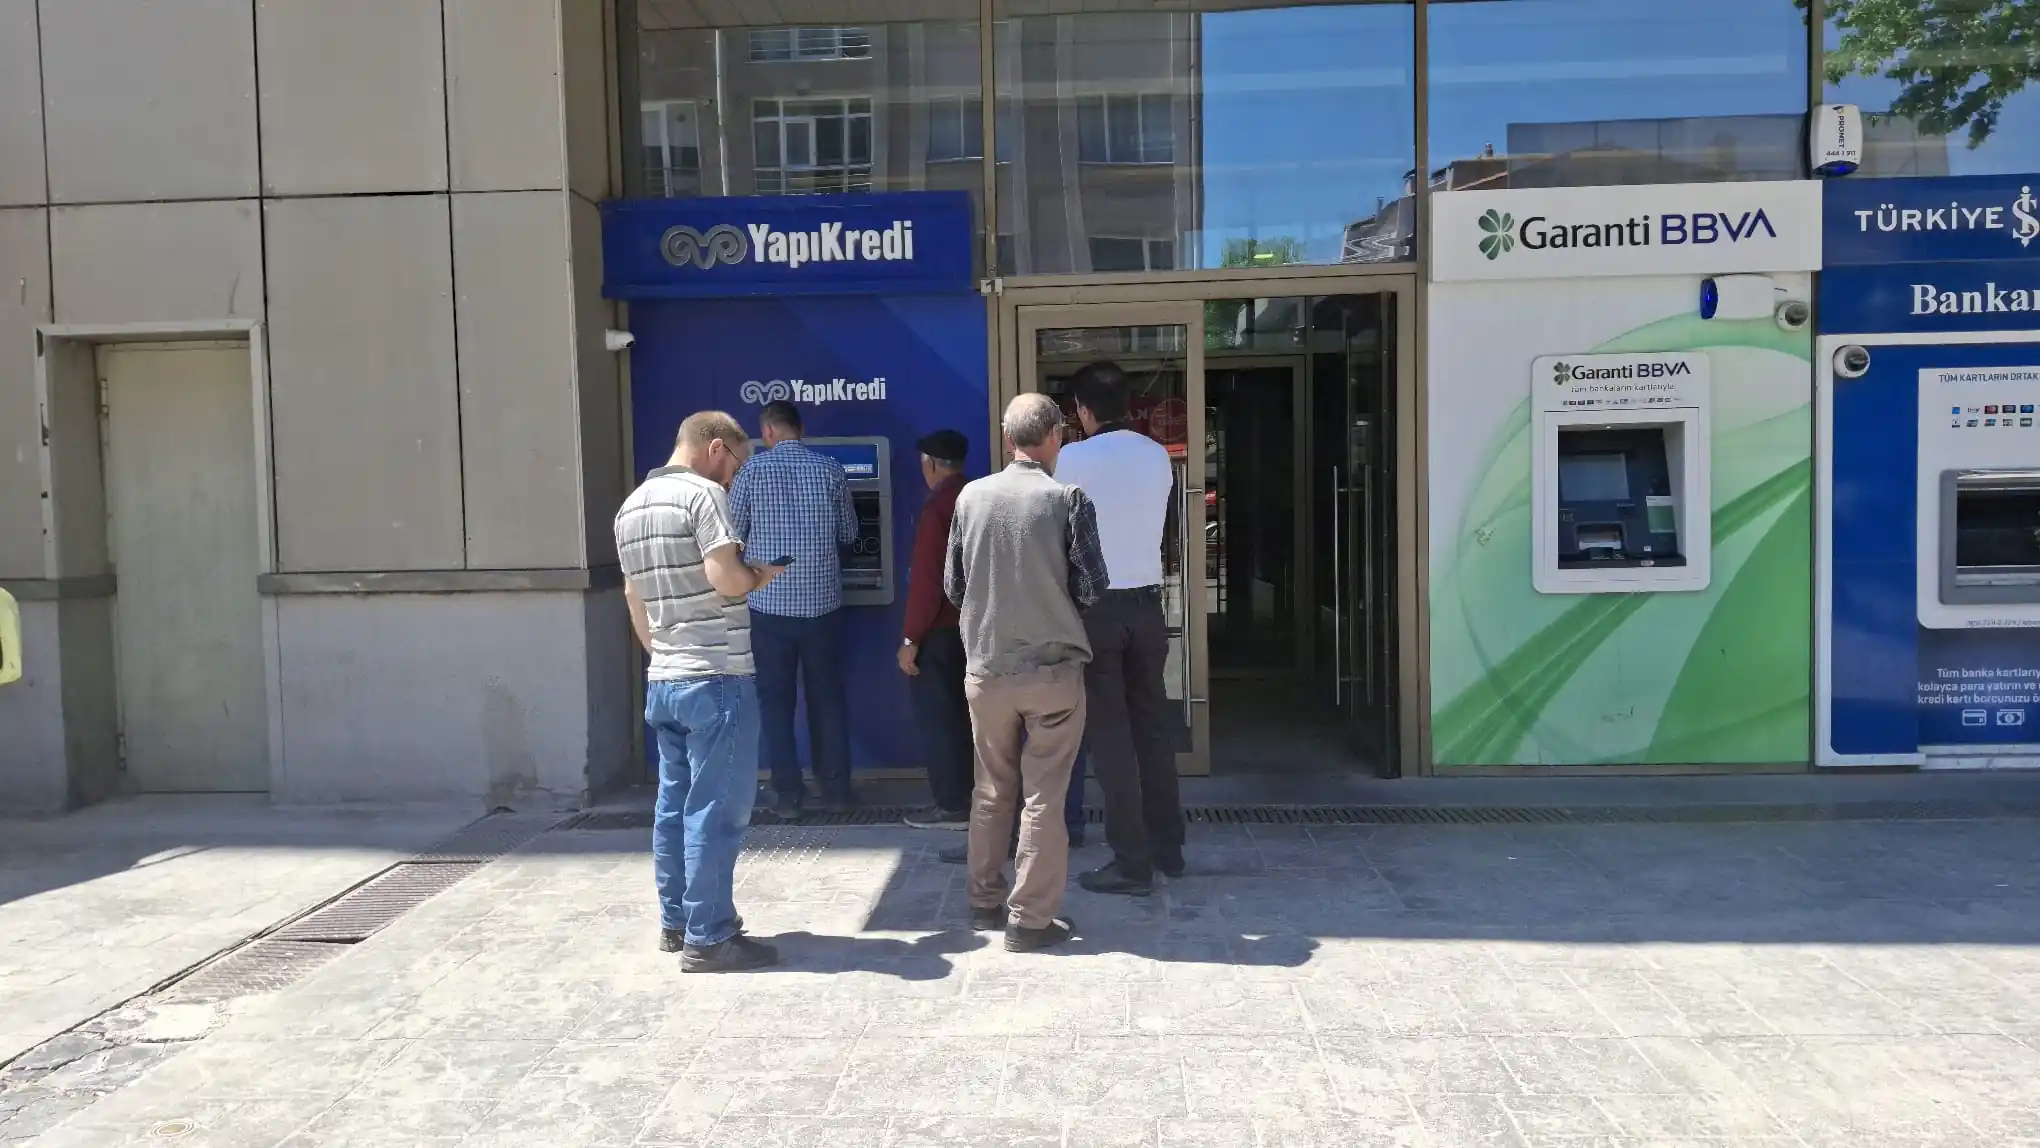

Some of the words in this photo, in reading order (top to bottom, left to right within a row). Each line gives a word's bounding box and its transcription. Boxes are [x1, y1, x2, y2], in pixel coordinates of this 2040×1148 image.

[1854, 201, 2005, 232] TÜRKİYE
[1519, 214, 1651, 249] Garanti
[1660, 208, 1777, 245] BBVA
[1571, 365, 1633, 380] Garanti
[1637, 361, 1691, 378] BBVA
[1939, 372, 1958, 383] TÜM
[1960, 373, 2009, 382] KARTLARIN
[2010, 372, 2039, 381] ORTAK
[1937, 668, 1959, 678] Tüm
[1961, 667, 1994, 678] banka
[1917, 681, 1958, 693] kolayca
[1960, 683, 1985, 693] para
[1917, 694, 1944, 704] kredi
